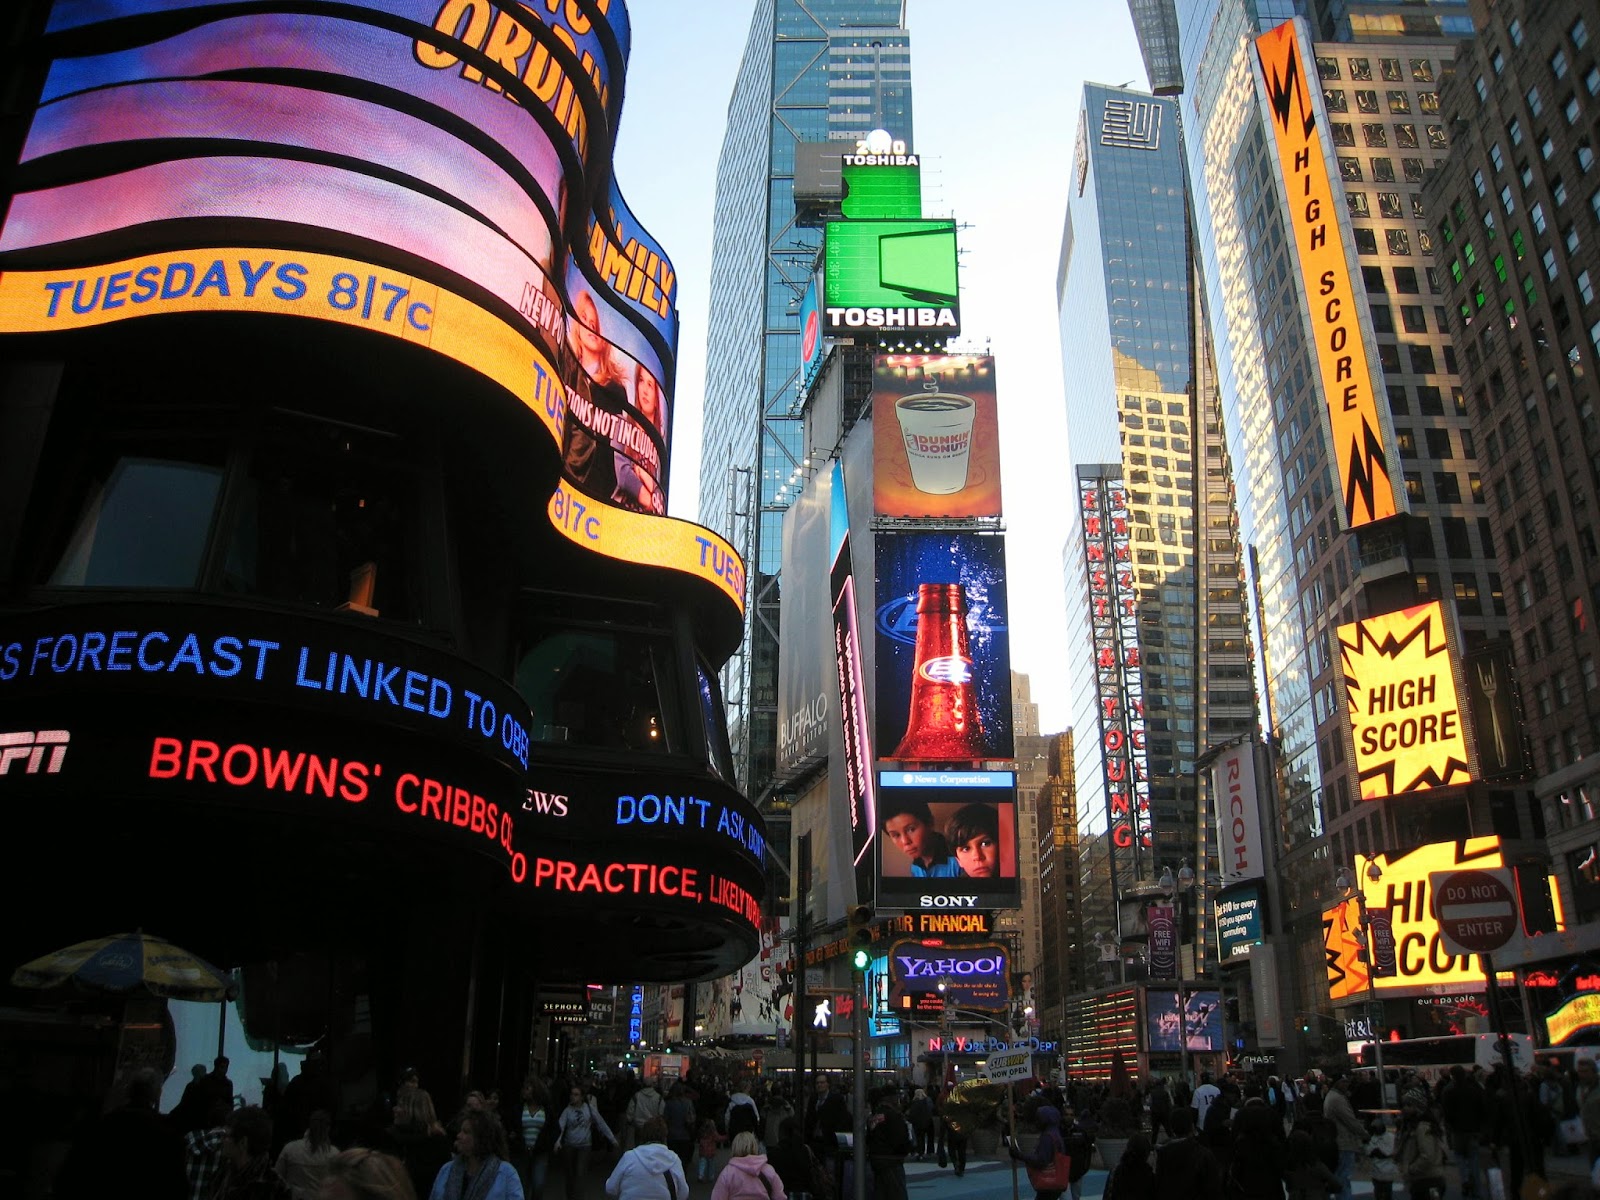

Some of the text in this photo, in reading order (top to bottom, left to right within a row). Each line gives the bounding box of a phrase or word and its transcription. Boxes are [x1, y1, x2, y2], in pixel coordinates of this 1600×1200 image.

[856, 140, 905, 155] 20
[843, 155, 918, 166] TOSHIBA
[567, 204, 675, 320] AMILY
[1294, 146, 1358, 412] HIGH SCORE
[44, 260, 306, 318] TUESDAYS
[826, 307, 957, 327] TOSHIBA
[592, 406, 618, 440] NOT
[920, 440, 967, 453] DONUTS
[1083, 490, 1132, 847] ERNST & YOUNG
[0, 642, 21, 680] S
[29, 631, 280, 681] FORECAST
[296, 646, 452, 719] LINKED
[464, 689, 497, 738] TO
[1368, 674, 1436, 716] HIGH
[781, 692, 828, 750] BUFFALO
[781, 741, 799, 762] DAVID
[803, 720, 828, 747] BITTON
[1360, 710, 1457, 756] SCORE
[149, 736, 382, 802] BROWNS'
[395, 773, 498, 840] CRIBBS
[915, 774, 991, 785] News Corporation
[616, 794, 711, 828] DON'T
[717, 806, 747, 850] ASK,
[1226, 758, 1248, 871] RICOH
[511, 852, 527, 883] O
[534, 857, 703, 903] PRACTICE,
[709, 874, 745, 915] LIKELY
[1447, 884, 1498, 900] DO NOT
[920, 895, 978, 907] SONY
[1240, 900, 1257, 909] every
[1385, 878, 1440, 924] HI
[920, 914, 988, 932] FINANCIAL
[1235, 910, 1252, 924] spend
[1154, 930, 1171, 938] FREE
[1374, 929, 1390, 938] FREE
[1458, 922, 1503, 937] ENTER
[1155, 938, 1171, 947] WIFI
[1232, 943, 1254, 956] CHAS
[1377, 937, 1391, 945] WIFI
[897, 955, 1002, 977] YAHOO!
[543, 1003, 583, 1011] SEPHORA
[1417, 997, 1452, 1006] europa
[956, 1036, 986, 1052] YORK
[1028, 1036, 1059, 1052] DEPT
[989, 1052, 1029, 1071] SUBWAY
[1243, 1055, 1275, 1064] CHASE
[991, 1067, 1028, 1079] NOW OPEN
